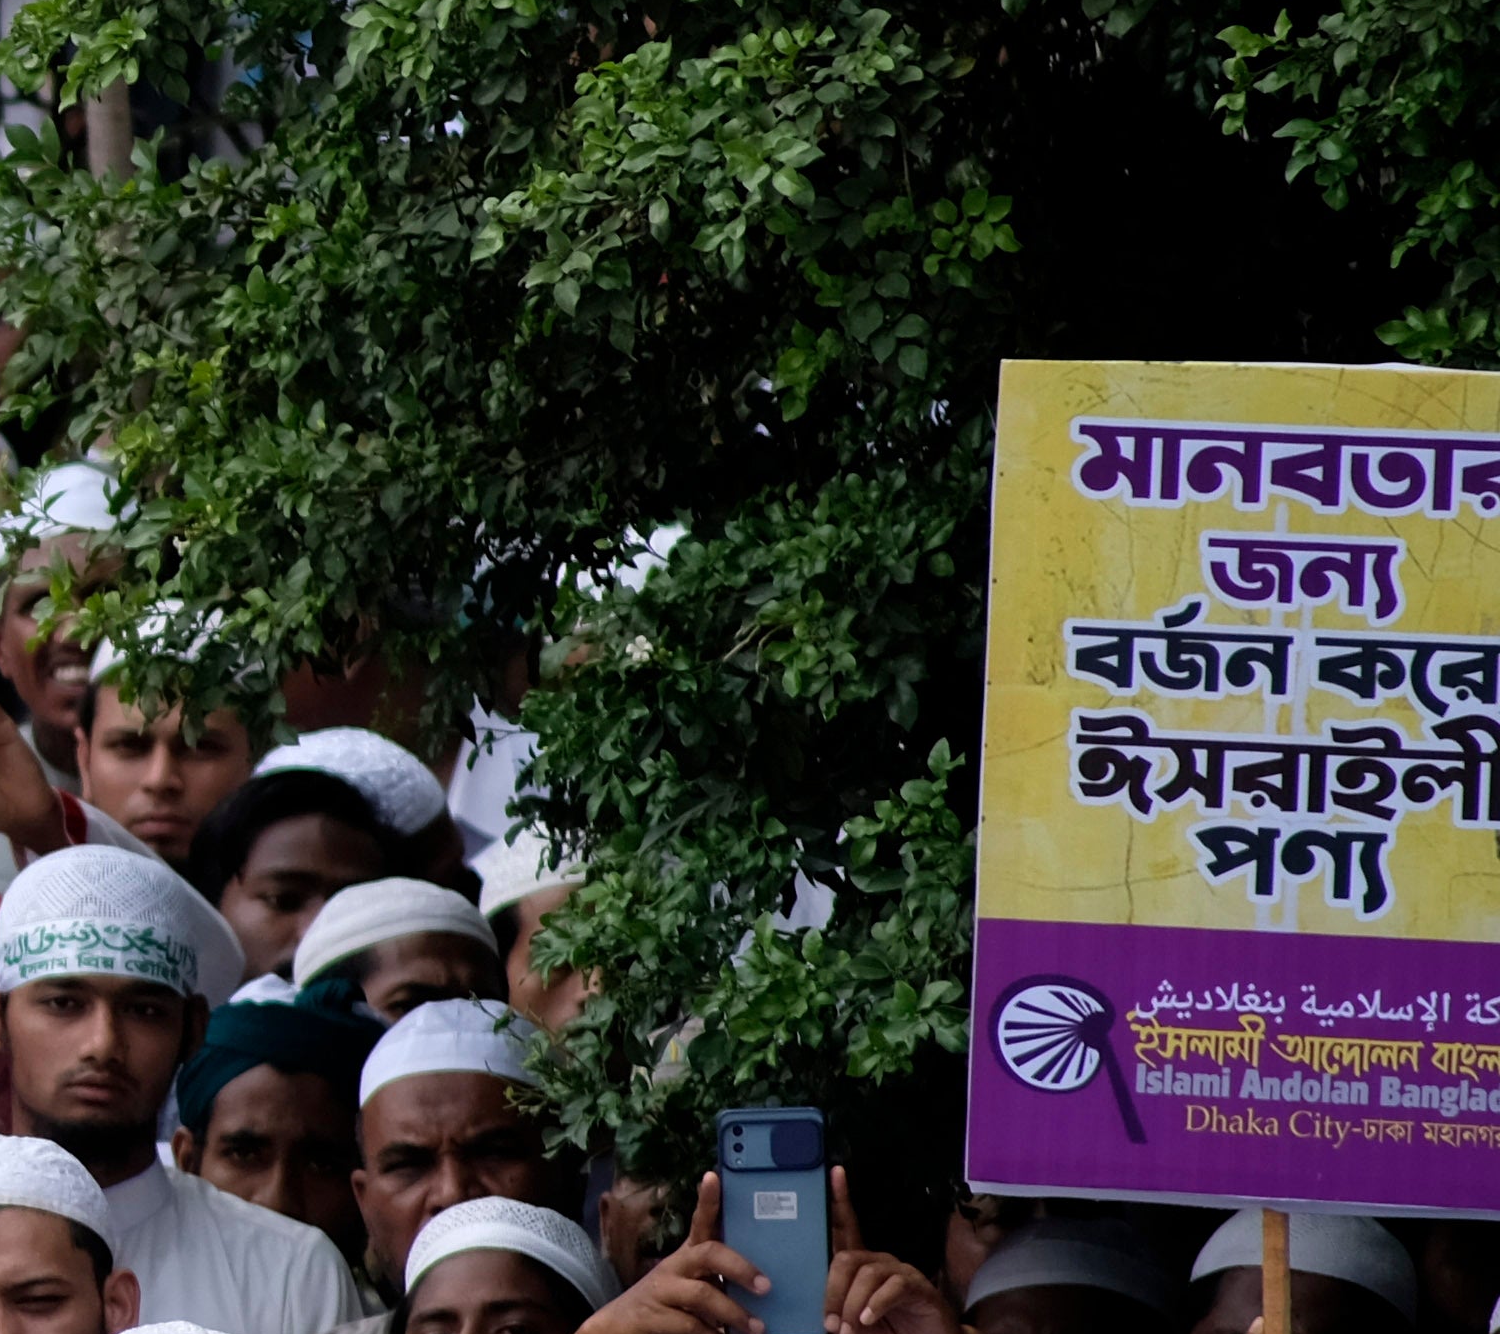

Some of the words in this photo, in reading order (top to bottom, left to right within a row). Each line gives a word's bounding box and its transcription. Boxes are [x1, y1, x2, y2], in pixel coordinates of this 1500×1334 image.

[1207, 536, 1399, 620] জন্য
[1071, 601, 1294, 696] বর্জন
[1195, 825, 1389, 914] পণ্য
[1134, 978, 1287, 1025] بنغلاديش
[1299, 982, 1452, 1033] الإسلامية
[1127, 1009, 1267, 1068] ইসলামী
[1270, 1033, 1425, 1078] আন্দোলন
[1134, 1061, 1232, 1099] Islami
[1238, 1068, 1370, 1106] Andolan
[1185, 1103, 1280, 1137] Dhaka
